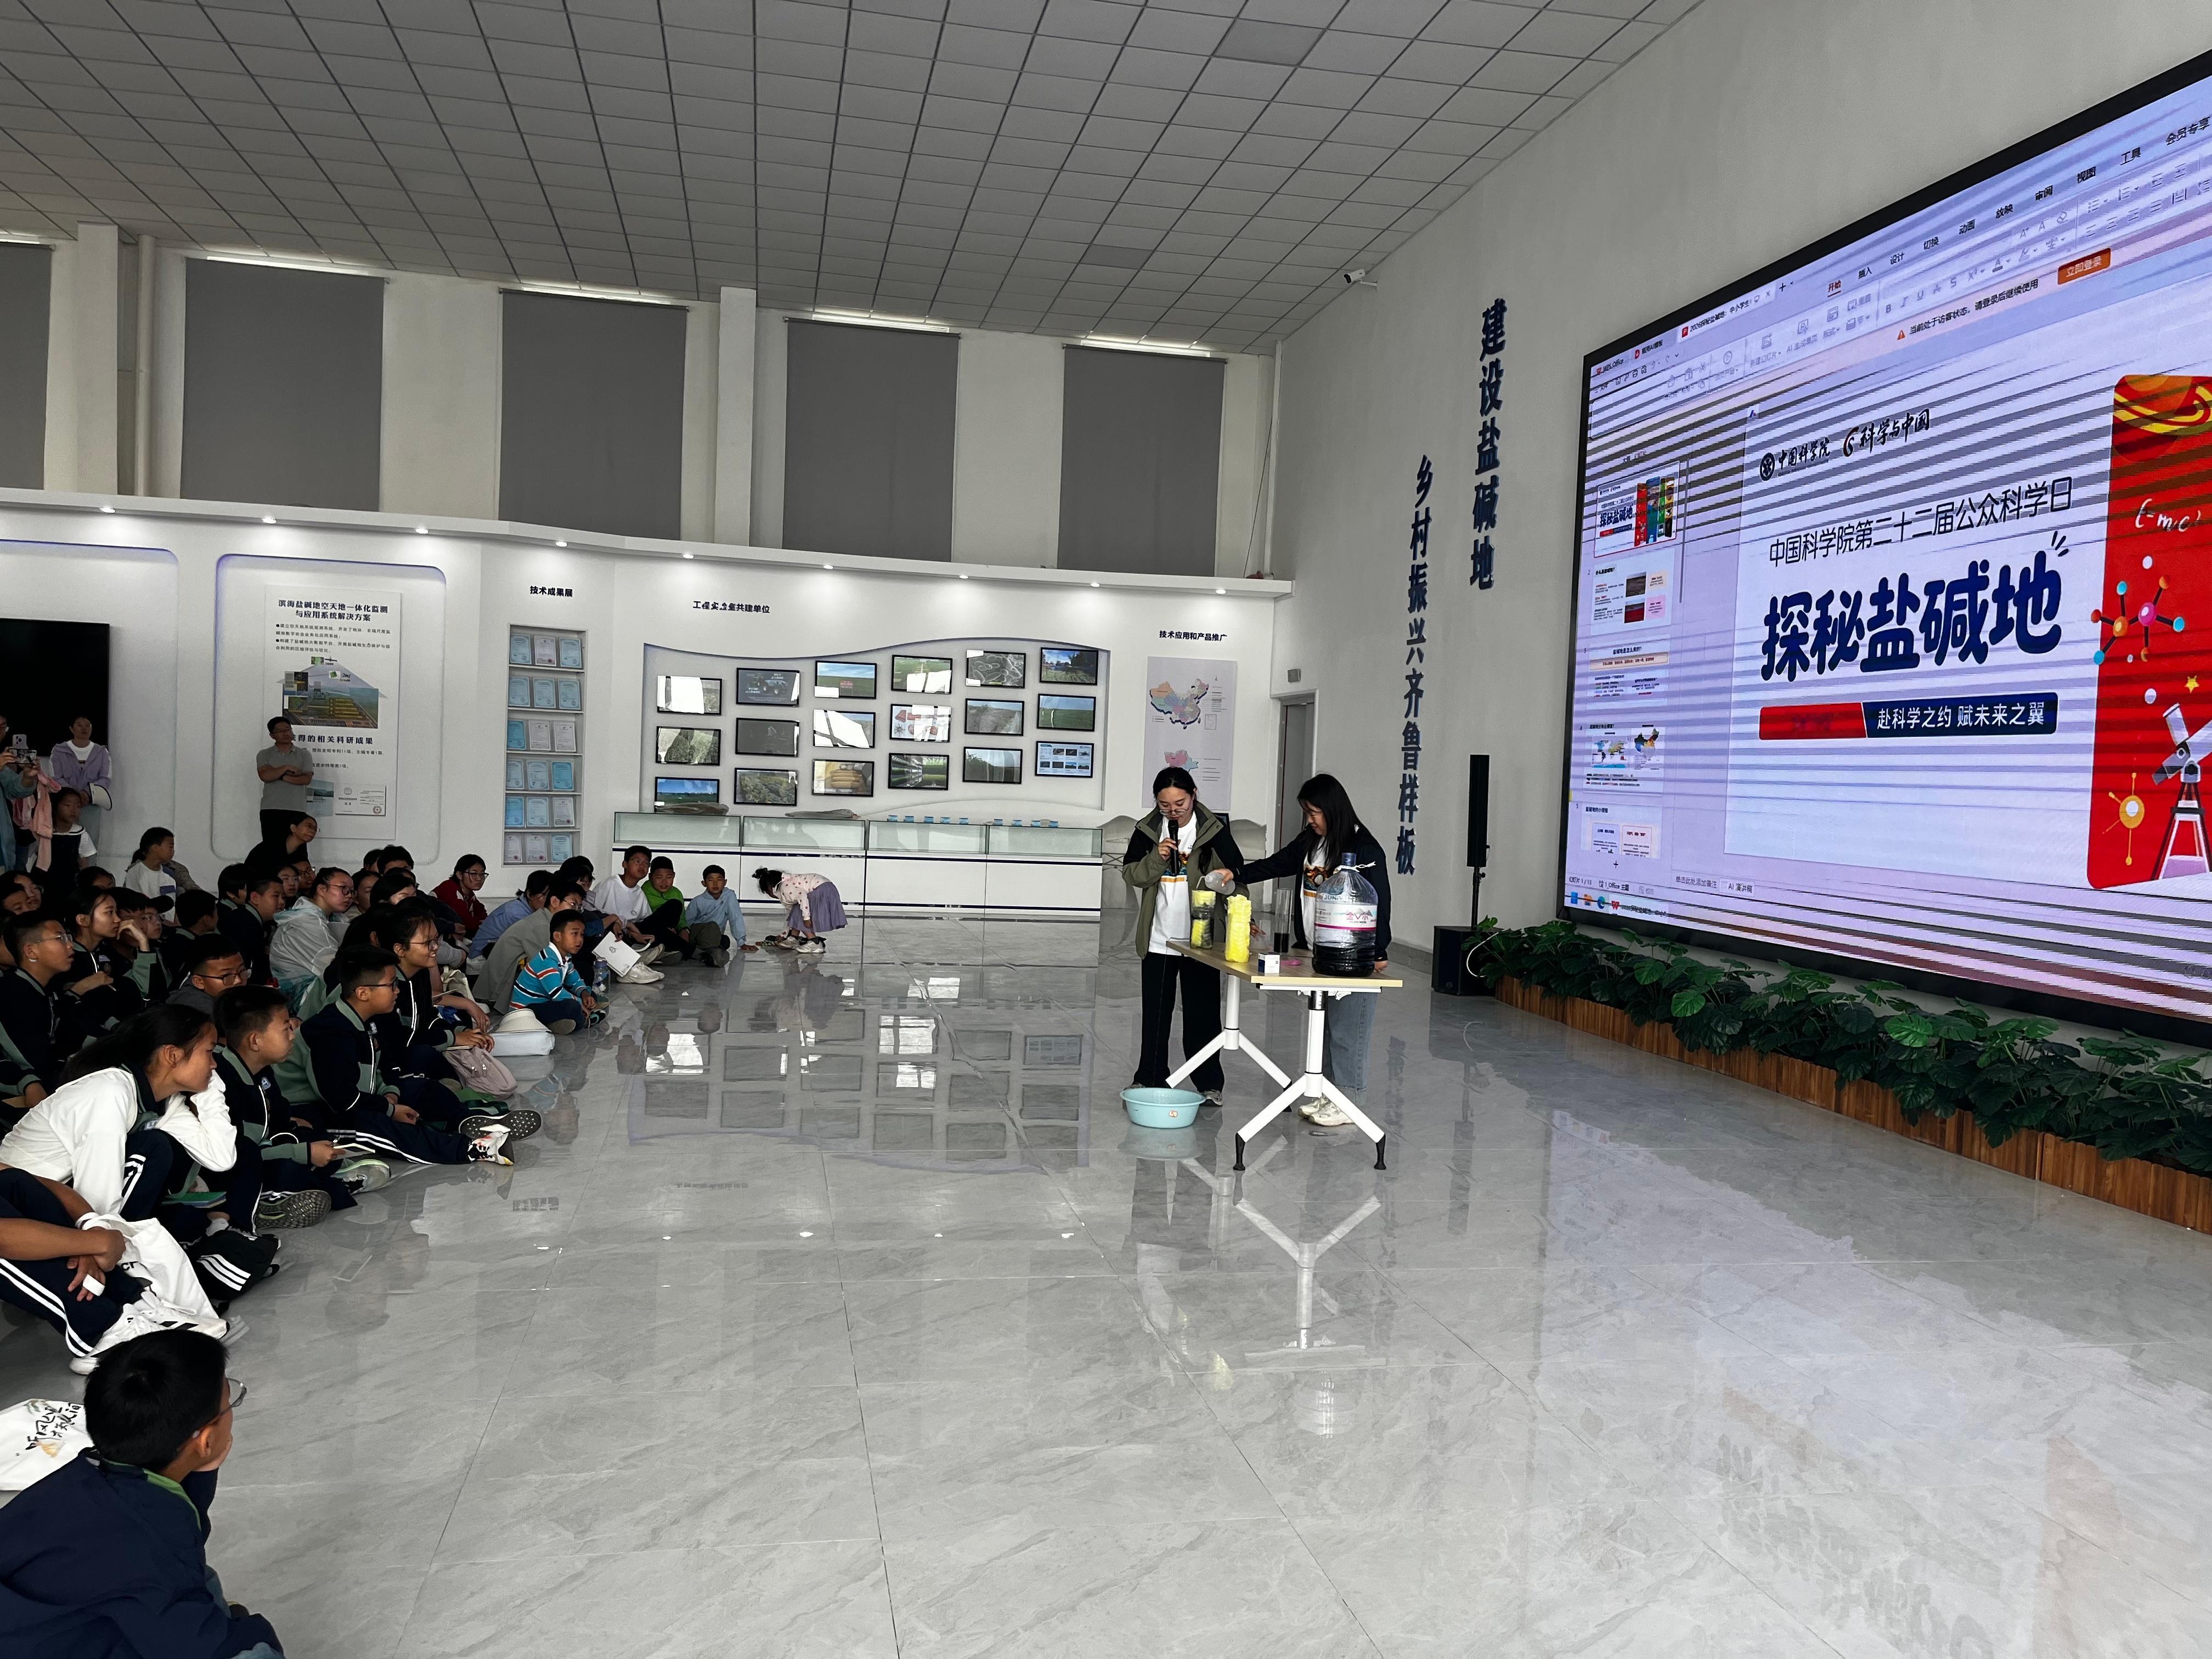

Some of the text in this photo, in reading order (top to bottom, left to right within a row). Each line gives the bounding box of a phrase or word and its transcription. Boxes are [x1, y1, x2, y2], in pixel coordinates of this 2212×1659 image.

[1828, 116, 2210, 292] 开始 插入 设计 切换 动画 放映 审阅 视图 工具 会员专享
[2066, 256, 2102, 277] 立即登录
[1470, 297, 1507, 591] 建设盐碱地
[1859, 408, 1930, 453] 科学与中国
[1778, 437, 1831, 470] 中国科学院
[1769, 476, 2072, 567] 中国科学院第二十二届公众科学日
[278, 599, 388, 613] 滨海盐碱地空天地一体化监测
[530, 585, 573, 597] 技术成果展
[296, 610, 371, 621] 与应用系统解决方案
[1761, 550, 2062, 682] 探秘盐碱地
[1159, 630, 1227, 641] 技术应用和产品推广
[1396, 455, 1432, 876] 乡村振兴齐鲁样板
[1877, 702, 2045, 730] 赴科学之约 赋未来之翼
